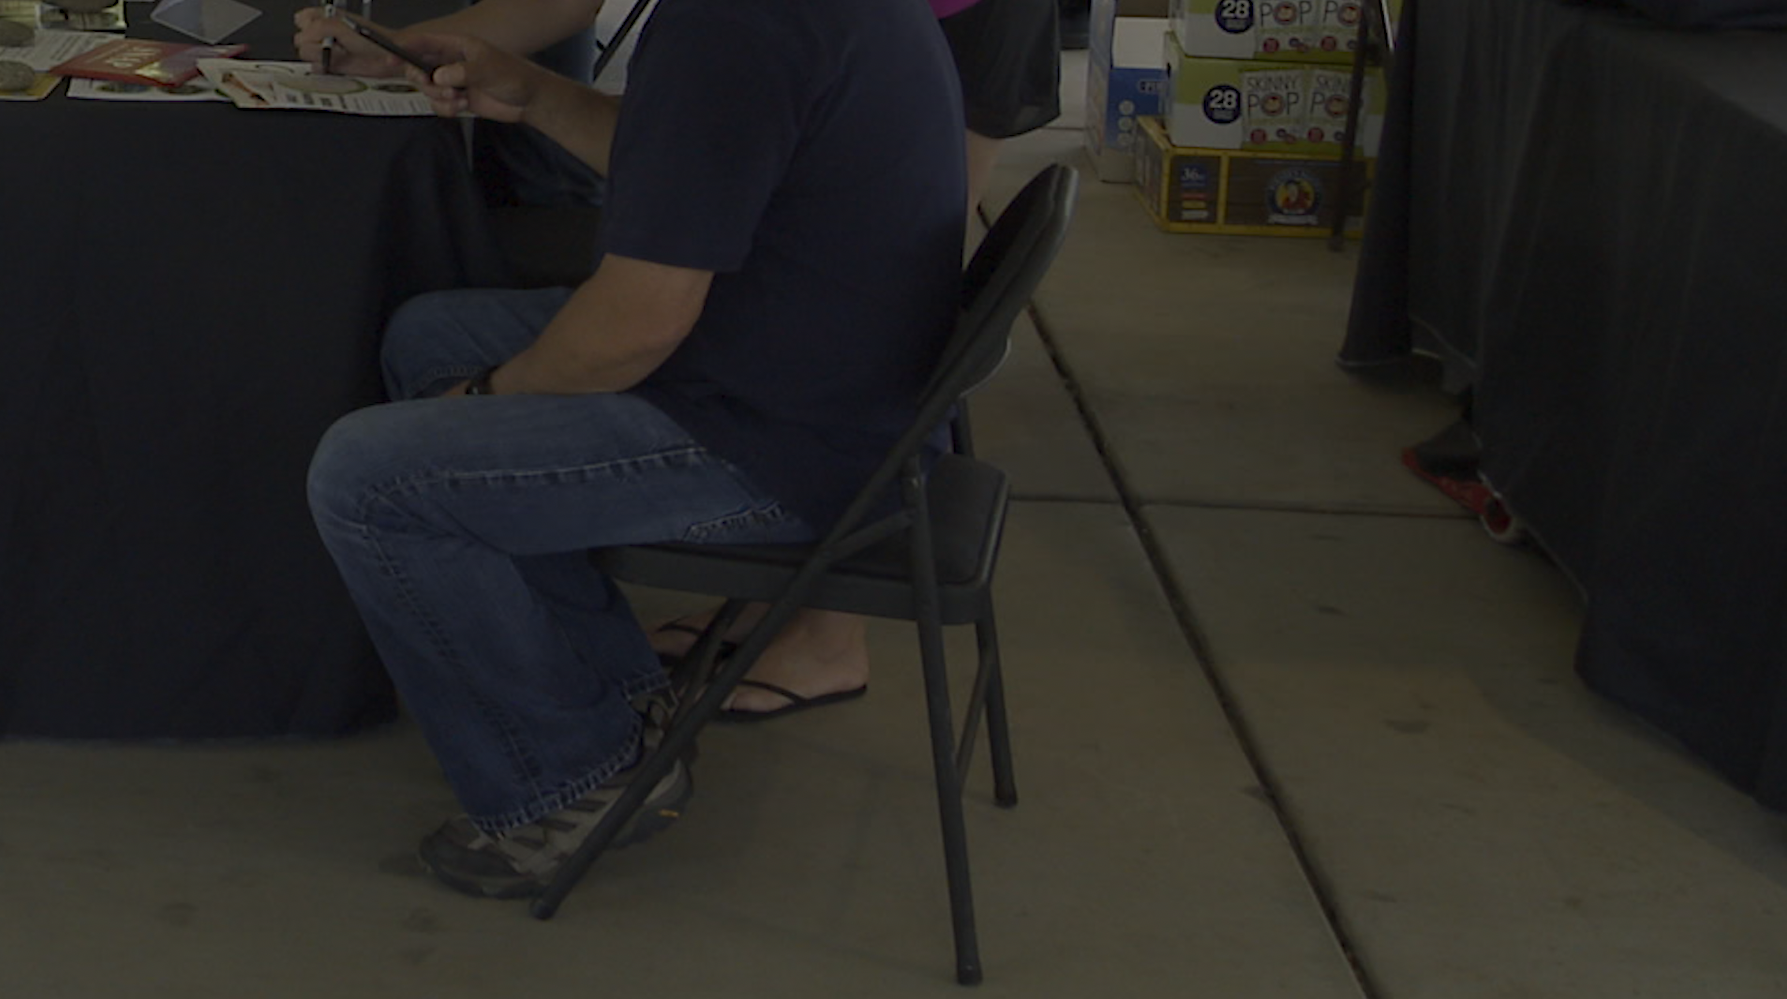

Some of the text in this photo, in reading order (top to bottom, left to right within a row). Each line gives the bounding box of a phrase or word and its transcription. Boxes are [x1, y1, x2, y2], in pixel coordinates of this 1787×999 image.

[1260, 1, 1313, 26] POP
[1323, 1, 1363, 26] PO
[1247, 75, 1299, 93] SKINNY
[1209, 88, 1238, 110] 28
[1247, 91, 1300, 119] POP
[1311, 91, 1349, 119] PO
